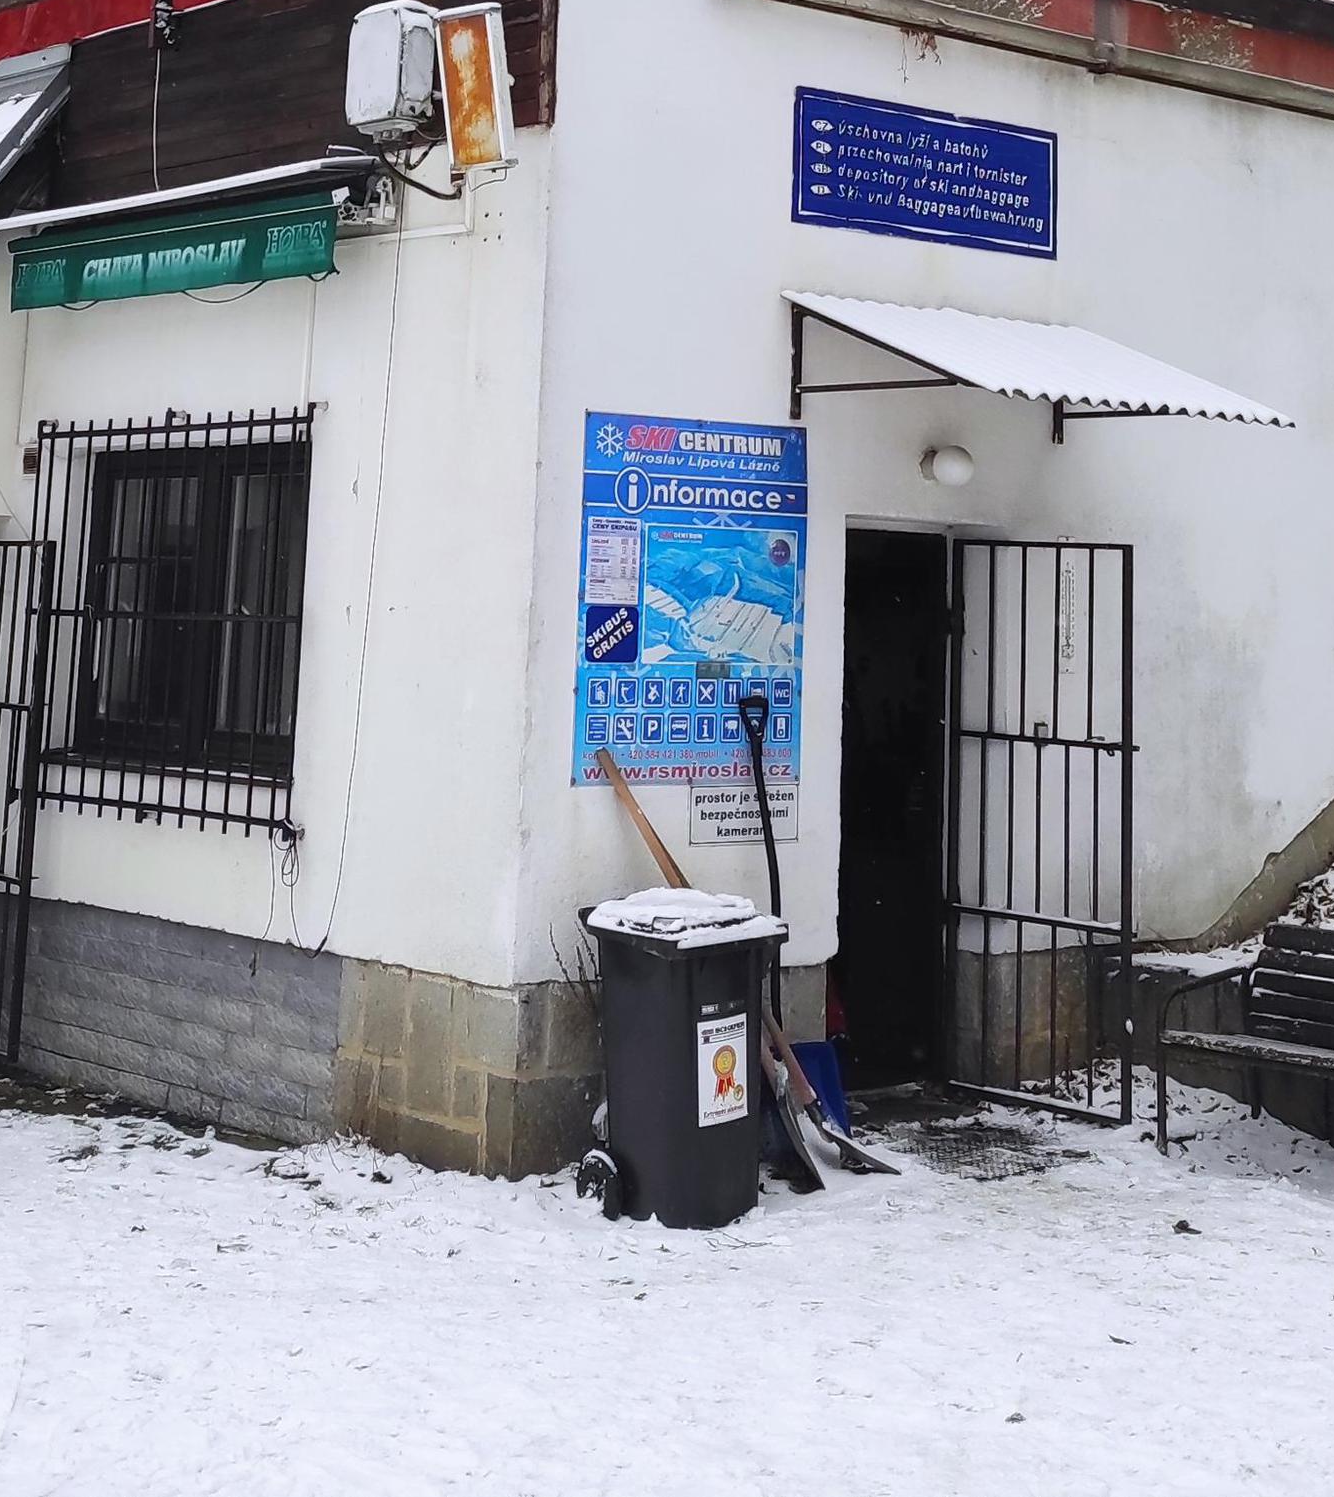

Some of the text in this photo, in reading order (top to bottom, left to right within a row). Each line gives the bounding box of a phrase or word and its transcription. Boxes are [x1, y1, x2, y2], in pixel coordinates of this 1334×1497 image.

[932, 139, 940, 151] a
[838, 144, 933, 170] przechowalnia
[937, 161, 963, 175] nart
[966, 162, 971, 178] i
[973, 164, 1028, 186] tornister
[837, 163, 910, 190] depository
[913, 176, 928, 190] of
[929, 178, 949, 194] ski
[82, 238, 247, 280] CHATA MIROSLAV
[625, 424, 782, 457] SKI CENTRUM
[622, 451, 685, 466] Miroslav
[688, 455, 736, 469] Lipová
[586, 607, 628, 648] SKIBUS
[593, 620, 635, 659] GRATIS
[774, 689, 790, 698] WC
[582, 762, 792, 780] ww.rsmirosla.cz
[695, 789, 794, 806] prostor je sežen
[700, 806, 789, 822] bezpečnosími
